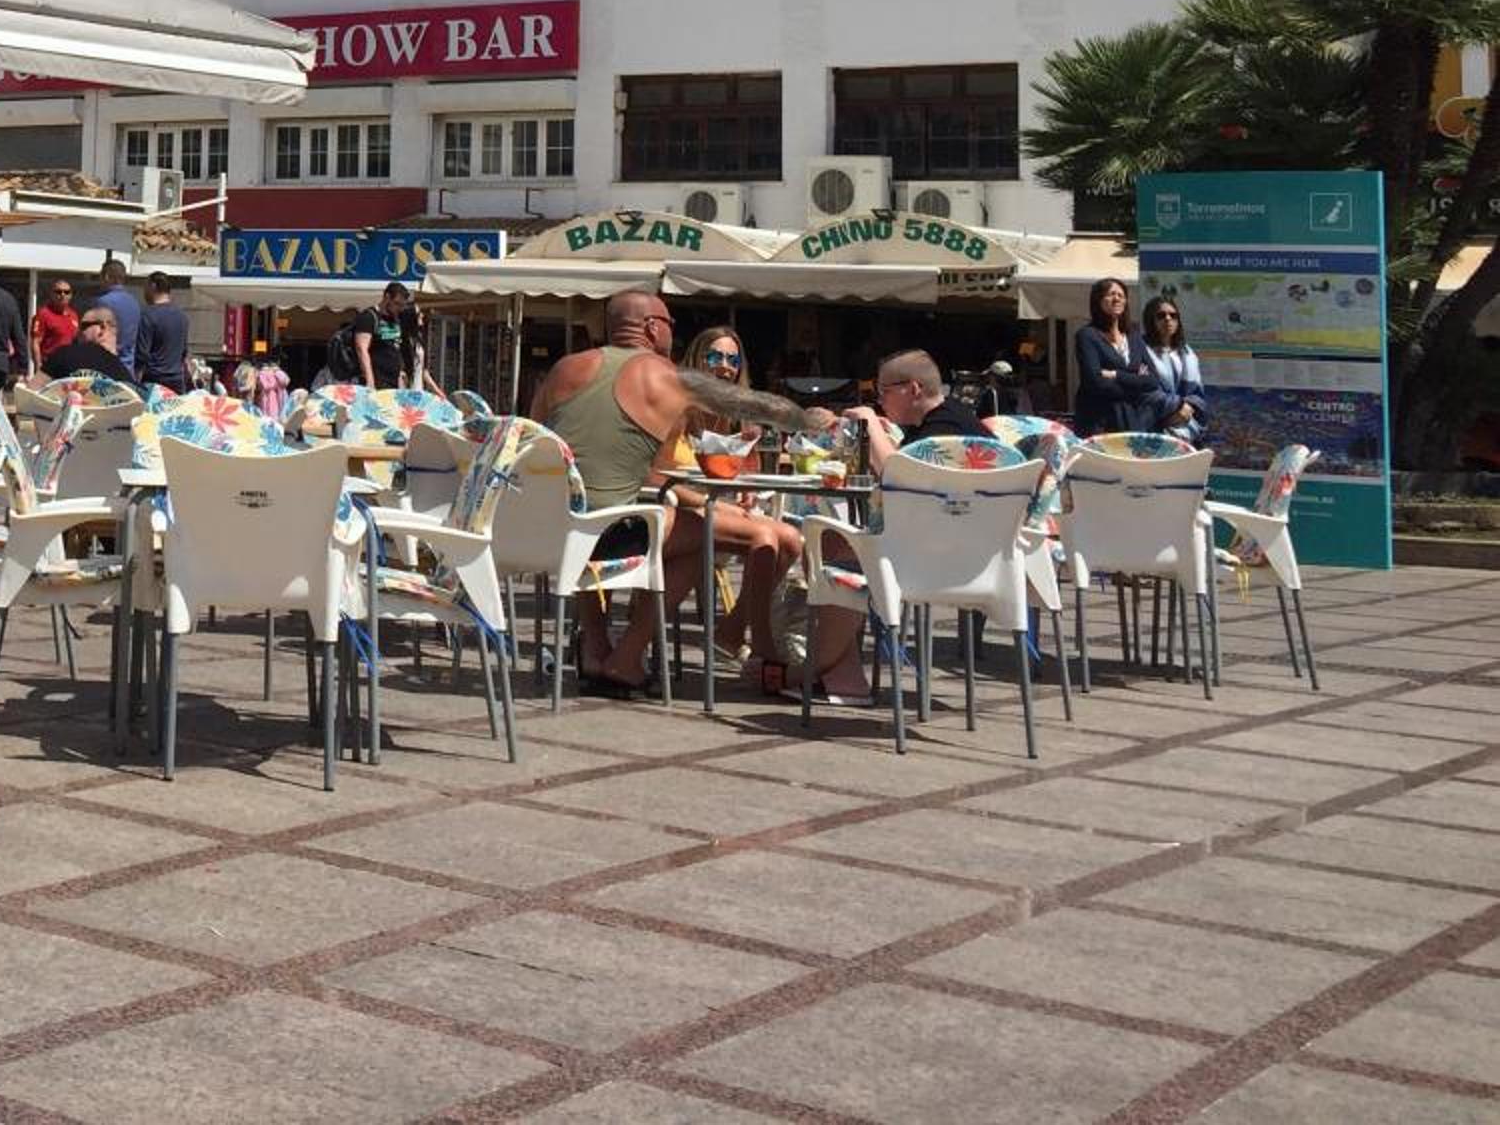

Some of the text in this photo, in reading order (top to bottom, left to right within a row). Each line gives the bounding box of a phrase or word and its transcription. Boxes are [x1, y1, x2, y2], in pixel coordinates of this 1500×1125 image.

[307, 14, 559, 68] HOW BAR
[565, 214, 705, 252] BAZAR
[800, 213, 989, 261] CHINO 5888
[225, 236, 361, 275] BAZAR
